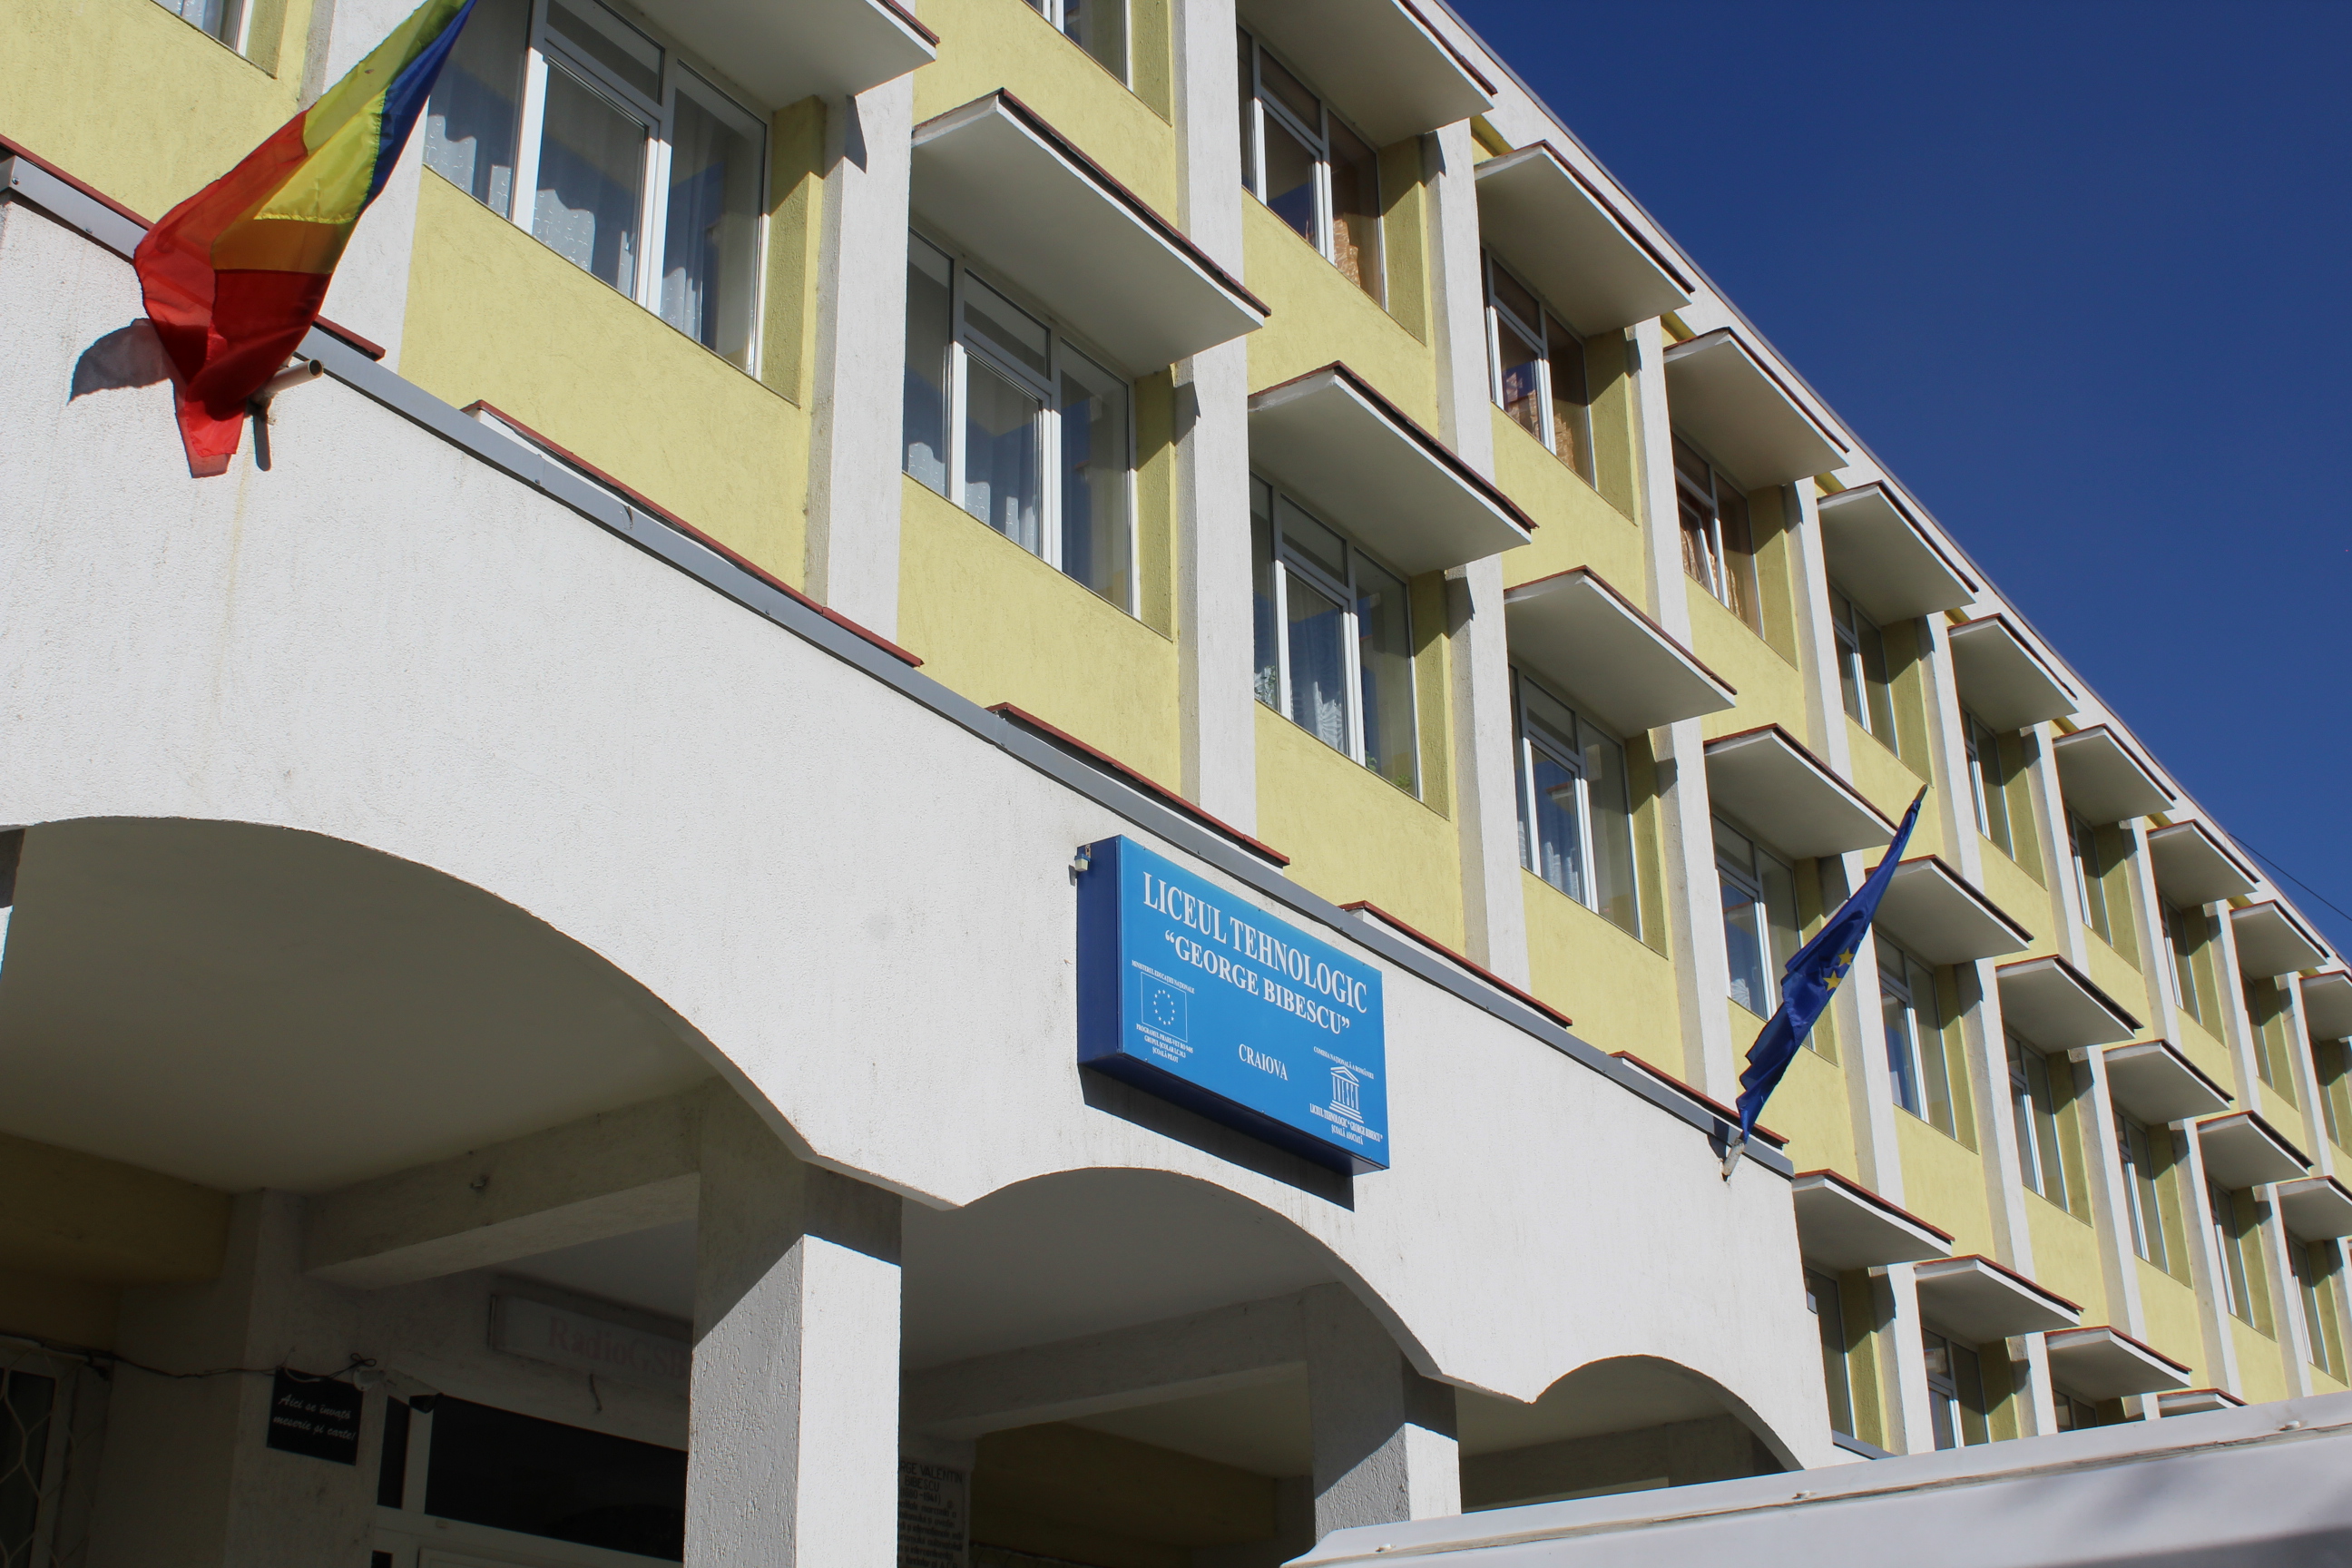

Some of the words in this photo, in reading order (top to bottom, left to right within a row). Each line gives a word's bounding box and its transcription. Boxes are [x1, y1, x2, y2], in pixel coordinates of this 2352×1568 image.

[1143, 872, 1227, 944] LICEUL
[1230, 916, 1367, 1013] TEHNOLOGIC
[1165, 930, 1259, 996] “GEORGE
[1263, 977, 1350, 1034] BIBESCU”
[1136, 1024, 1160, 1040] PROGRAMUL
[1167, 1052, 1179, 1063] PILOT
[1313, 1046, 1330, 1058] COMISIA
[1239, 1044, 1289, 1081] CRAIOVA
[1332, 1076, 1359, 1110] UNESCO
[1309, 1102, 1324, 1117] LICEUL
[278, 1394, 303, 1408] Aici
[305, 1403, 317, 1412] se
[273, 1416, 311, 1430] meserie
[920, 1465, 963, 1484] VALENTIN
[905, 1475, 940, 1493] BIBESCU
